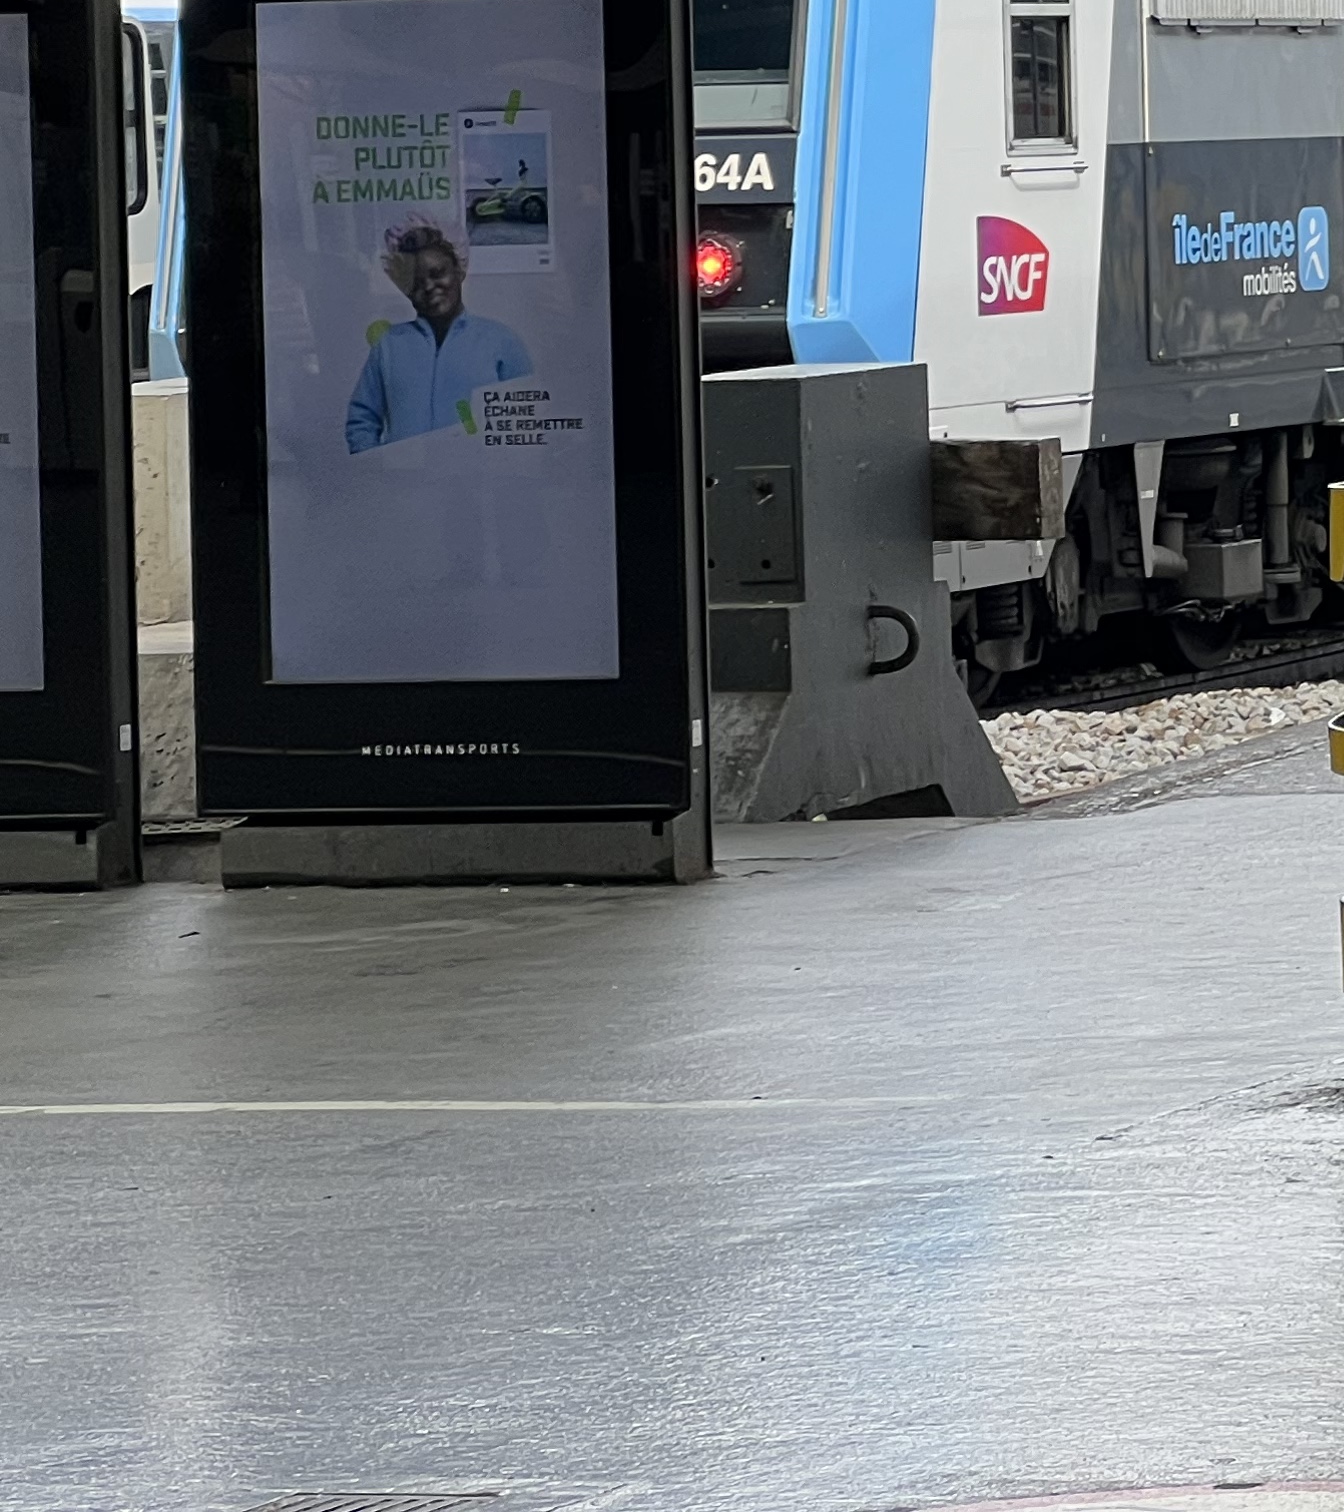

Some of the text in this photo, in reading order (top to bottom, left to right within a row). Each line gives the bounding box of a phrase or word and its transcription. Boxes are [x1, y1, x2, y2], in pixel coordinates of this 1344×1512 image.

[316, 112, 450, 140] DONNE-LE
[354, 140, 451, 171] PLUTÔT
[313, 172, 451, 203] À EMMAÜS
[979, 252, 1047, 304] SNCF
[1242, 264, 1297, 297] mobilités
[483, 391, 550, 405] ÇA AIDERA
[484, 417, 584, 432] À SE REMETTRE
[485, 434, 502, 446] EN
[361, 743, 520, 756] MEDIATRANSPORTS
